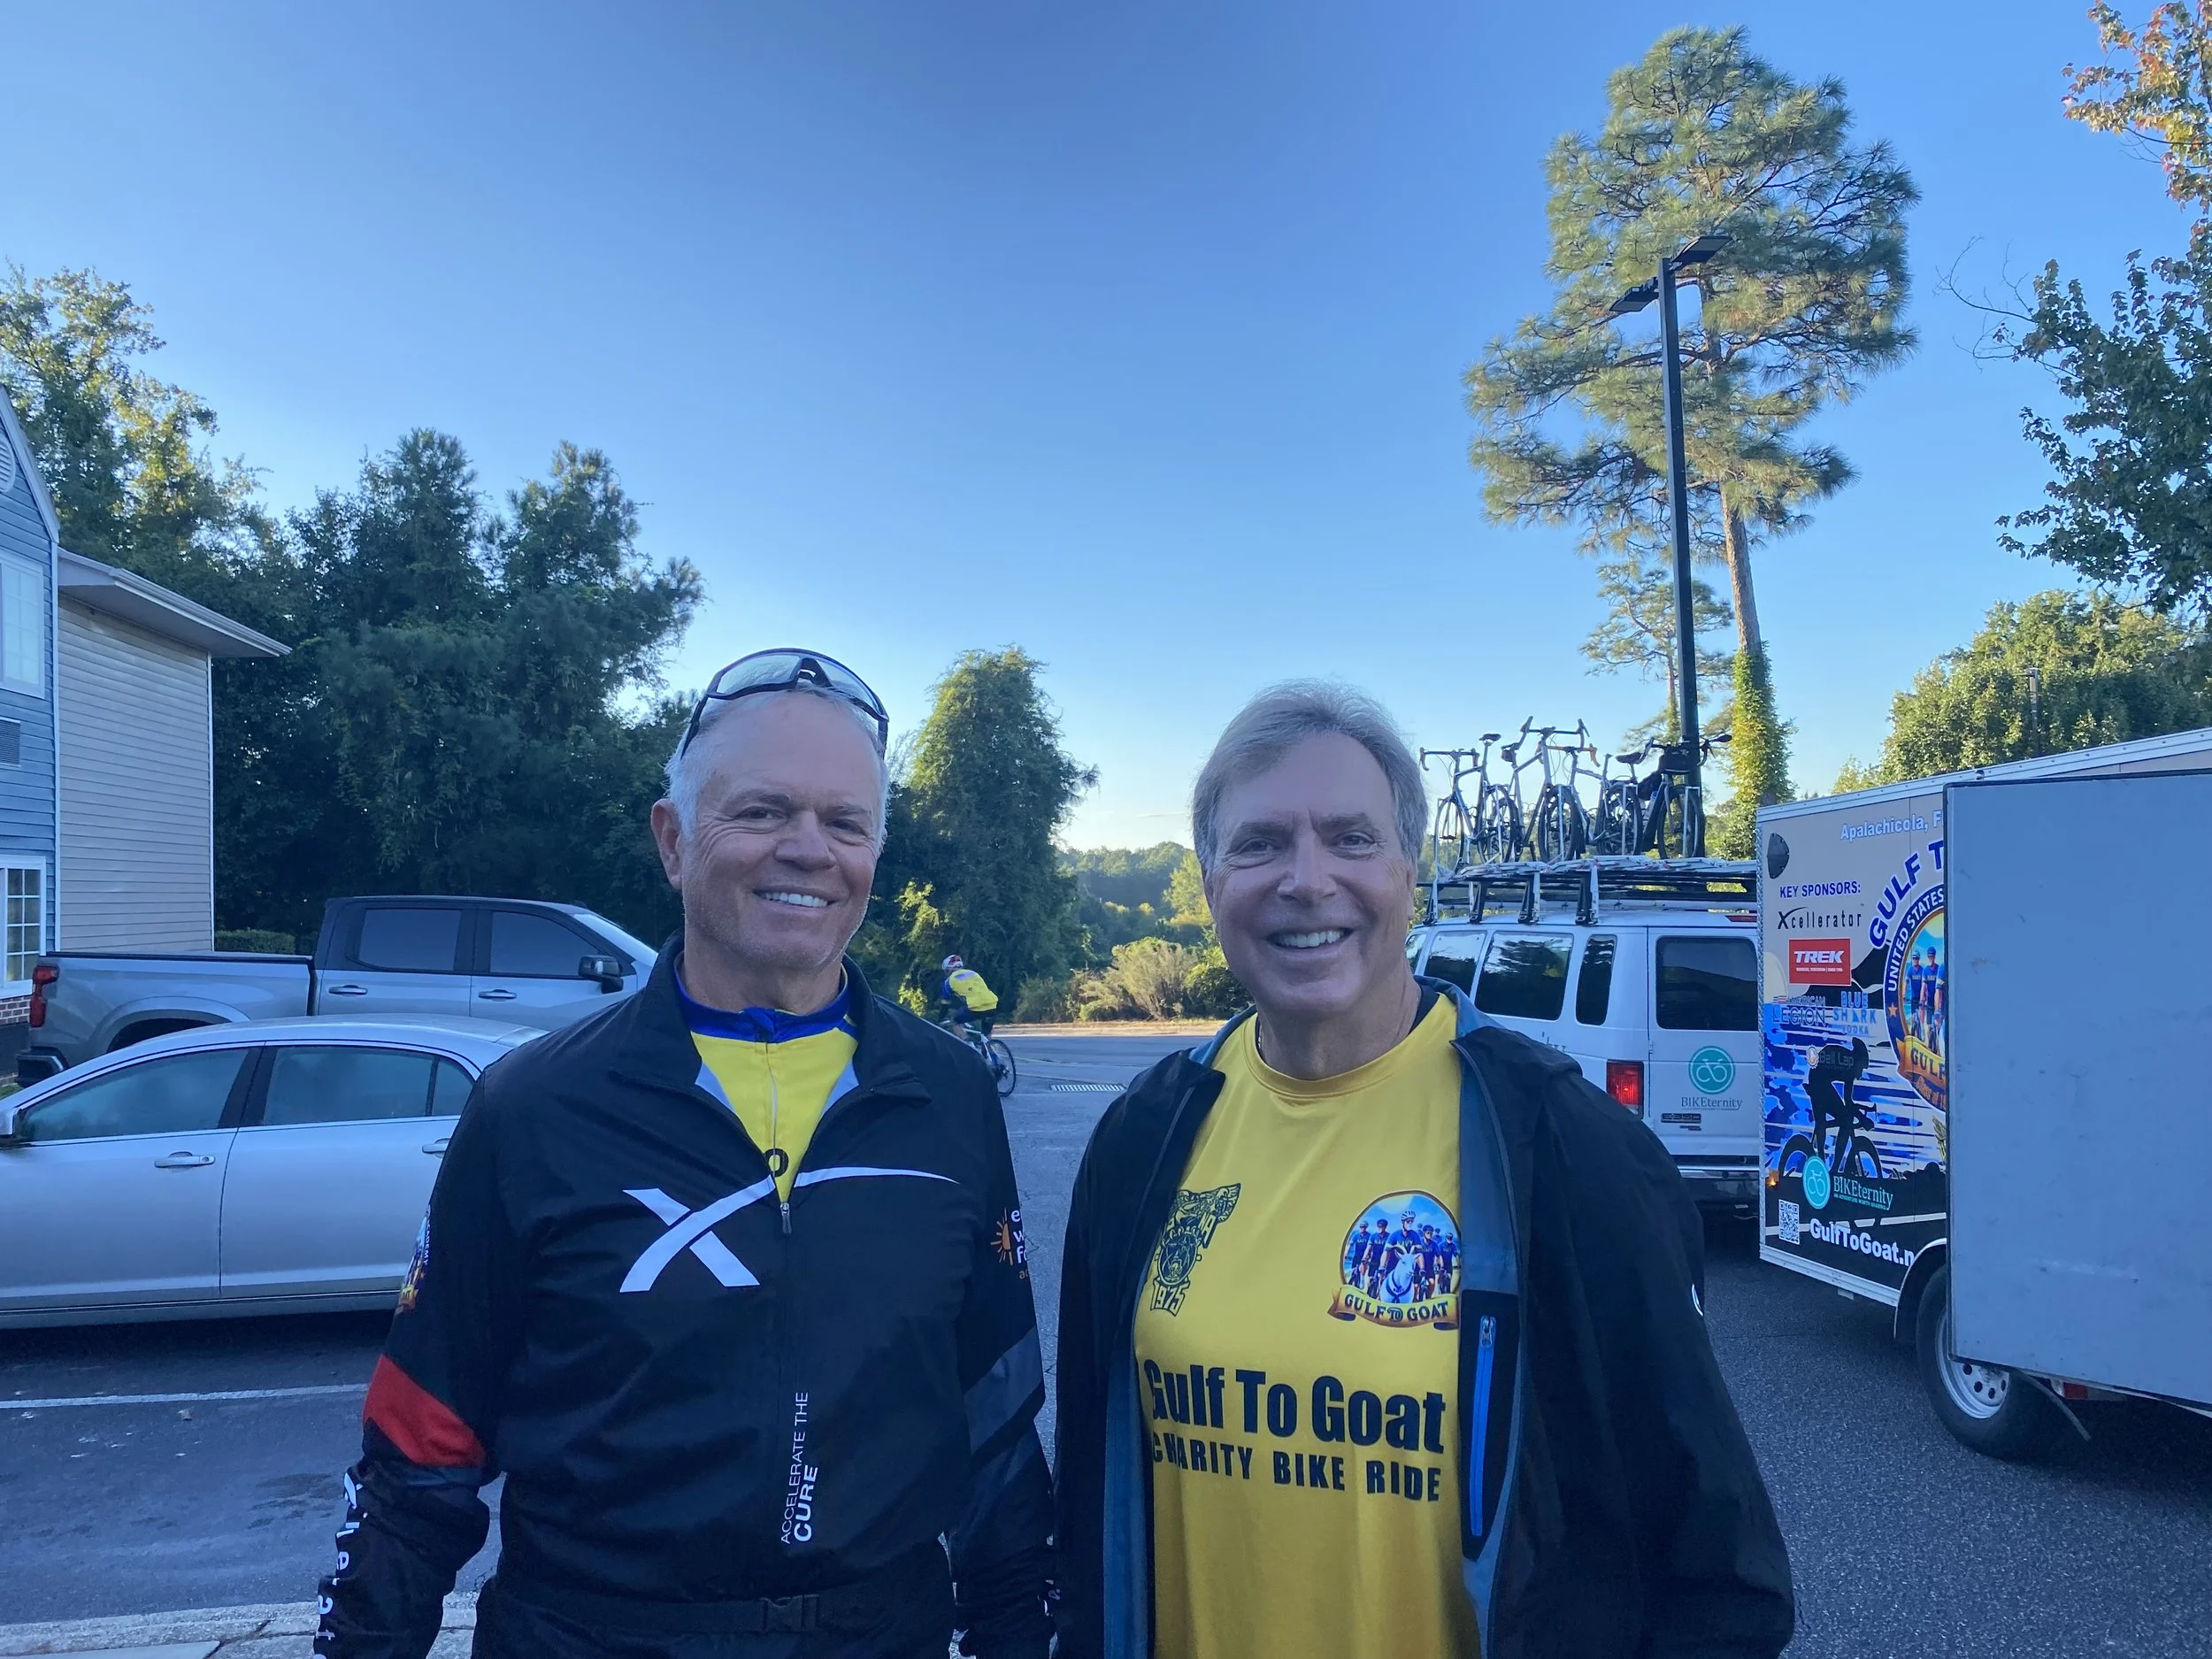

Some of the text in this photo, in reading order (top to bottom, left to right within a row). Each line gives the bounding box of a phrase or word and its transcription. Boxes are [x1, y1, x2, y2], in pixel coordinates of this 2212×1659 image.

[1840, 813, 1929, 841] Apalachicola,
[1779, 881, 1861, 898] KEY SPONSORS:
[1868, 850, 1922, 949] GULF
[1778, 906, 1862, 929] Xcellerator
[1887, 887, 1944, 992] UNITED STATES
[1793, 950, 1844, 964] TREK
[1787, 995, 1826, 1007] AMERICAN
[1840, 990, 1869, 1008] BLUE
[1772, 1007, 1826, 1026] LEGION
[1681, 1096, 1743, 1111] BIKEternity
[1833, 1175, 1893, 1211] BIKEternity
[1809, 1217, 1915, 1267] GulfToGoat.n
[1345, 1293, 1448, 1322] GULF TO GOAT
[1143, 1359, 1446, 1455] Gulf To Goat
[780, 1391, 809, 1545] ACCELERATE THE
[1151, 1429, 1441, 1502] CHARITY BIKE RIDE
[793, 1464, 819, 1542] CURE
